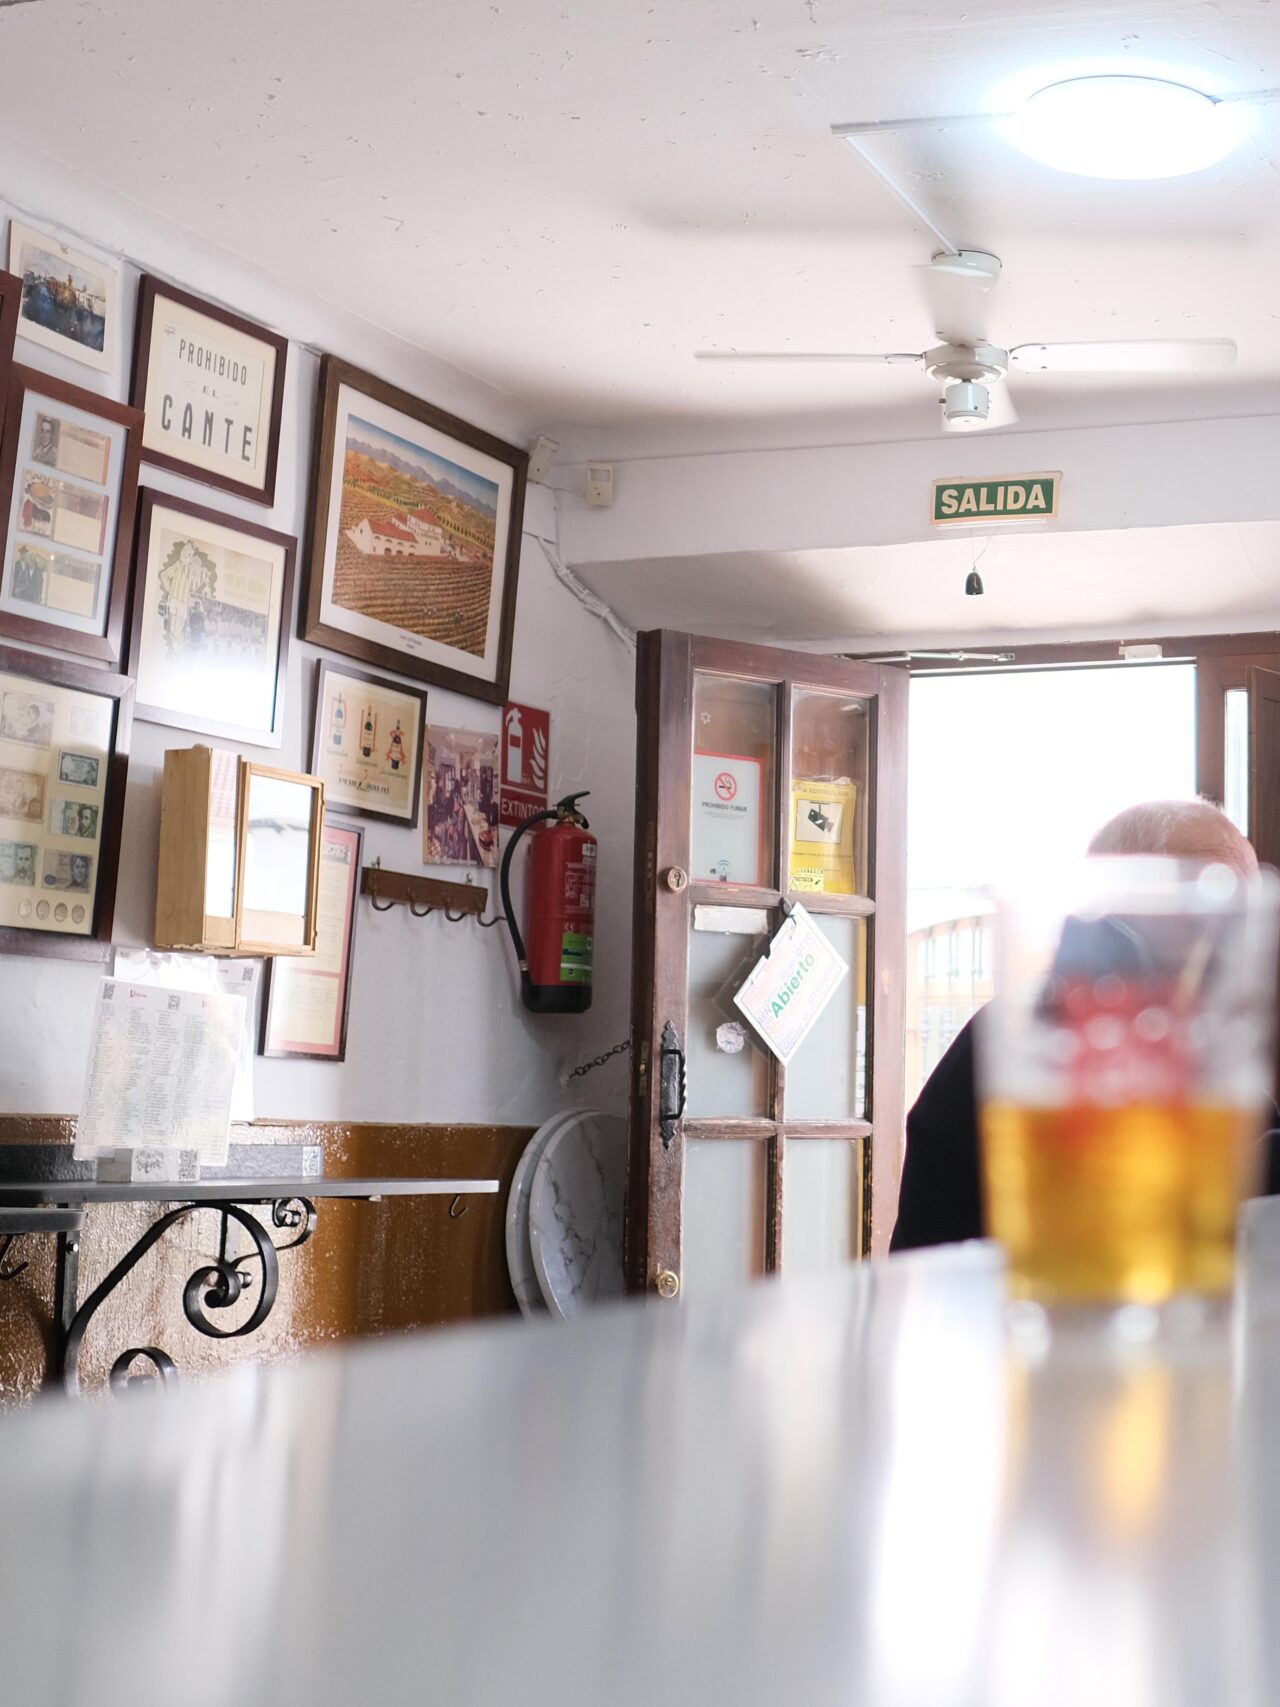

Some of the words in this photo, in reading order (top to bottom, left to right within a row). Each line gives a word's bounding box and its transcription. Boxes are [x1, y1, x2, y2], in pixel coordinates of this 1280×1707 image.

[178, 338, 248, 386] PROHIBIDO
[161, 394, 253, 462] CANTE
[940, 483, 1047, 515] SALIDA
[769, 952, 816, 1019] Abierto
